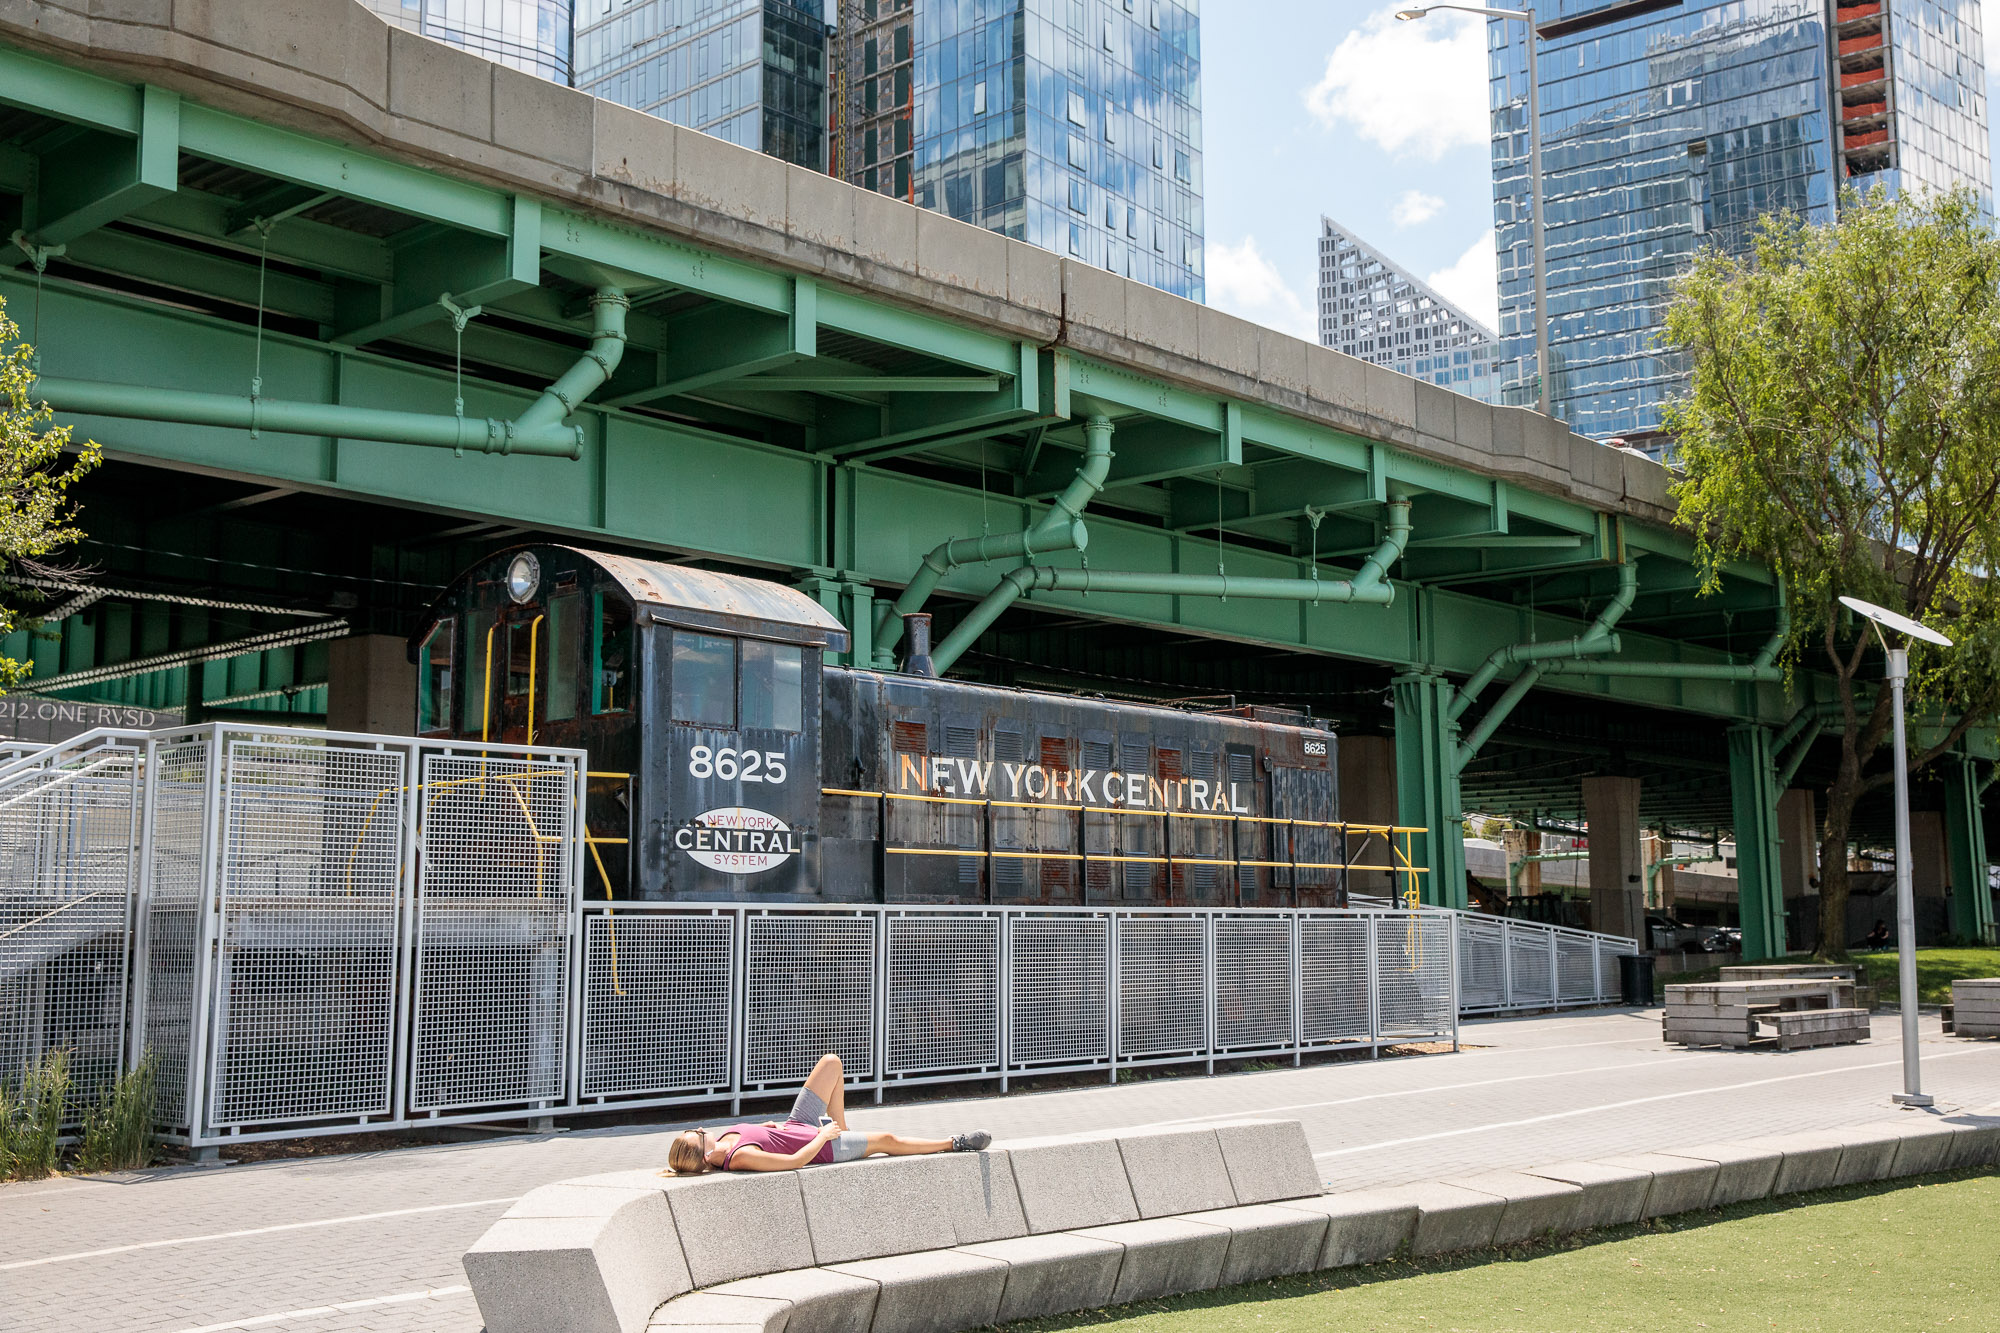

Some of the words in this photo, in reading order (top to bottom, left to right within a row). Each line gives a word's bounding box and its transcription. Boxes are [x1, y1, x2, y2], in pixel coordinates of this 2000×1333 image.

[1304, 743, 1327, 755] 8625
[689, 745, 787, 784] 8625
[900, 754, 995, 795] NEW
[1003, 763, 1097, 803] YORK
[1103, 771, 1249, 814] CENTRAL
[707, 814, 738, 826] NEW
[741, 816, 774, 829] YORK
[675, 828, 800, 854] CENTRAL
[714, 854, 768, 866] SYSTEM
